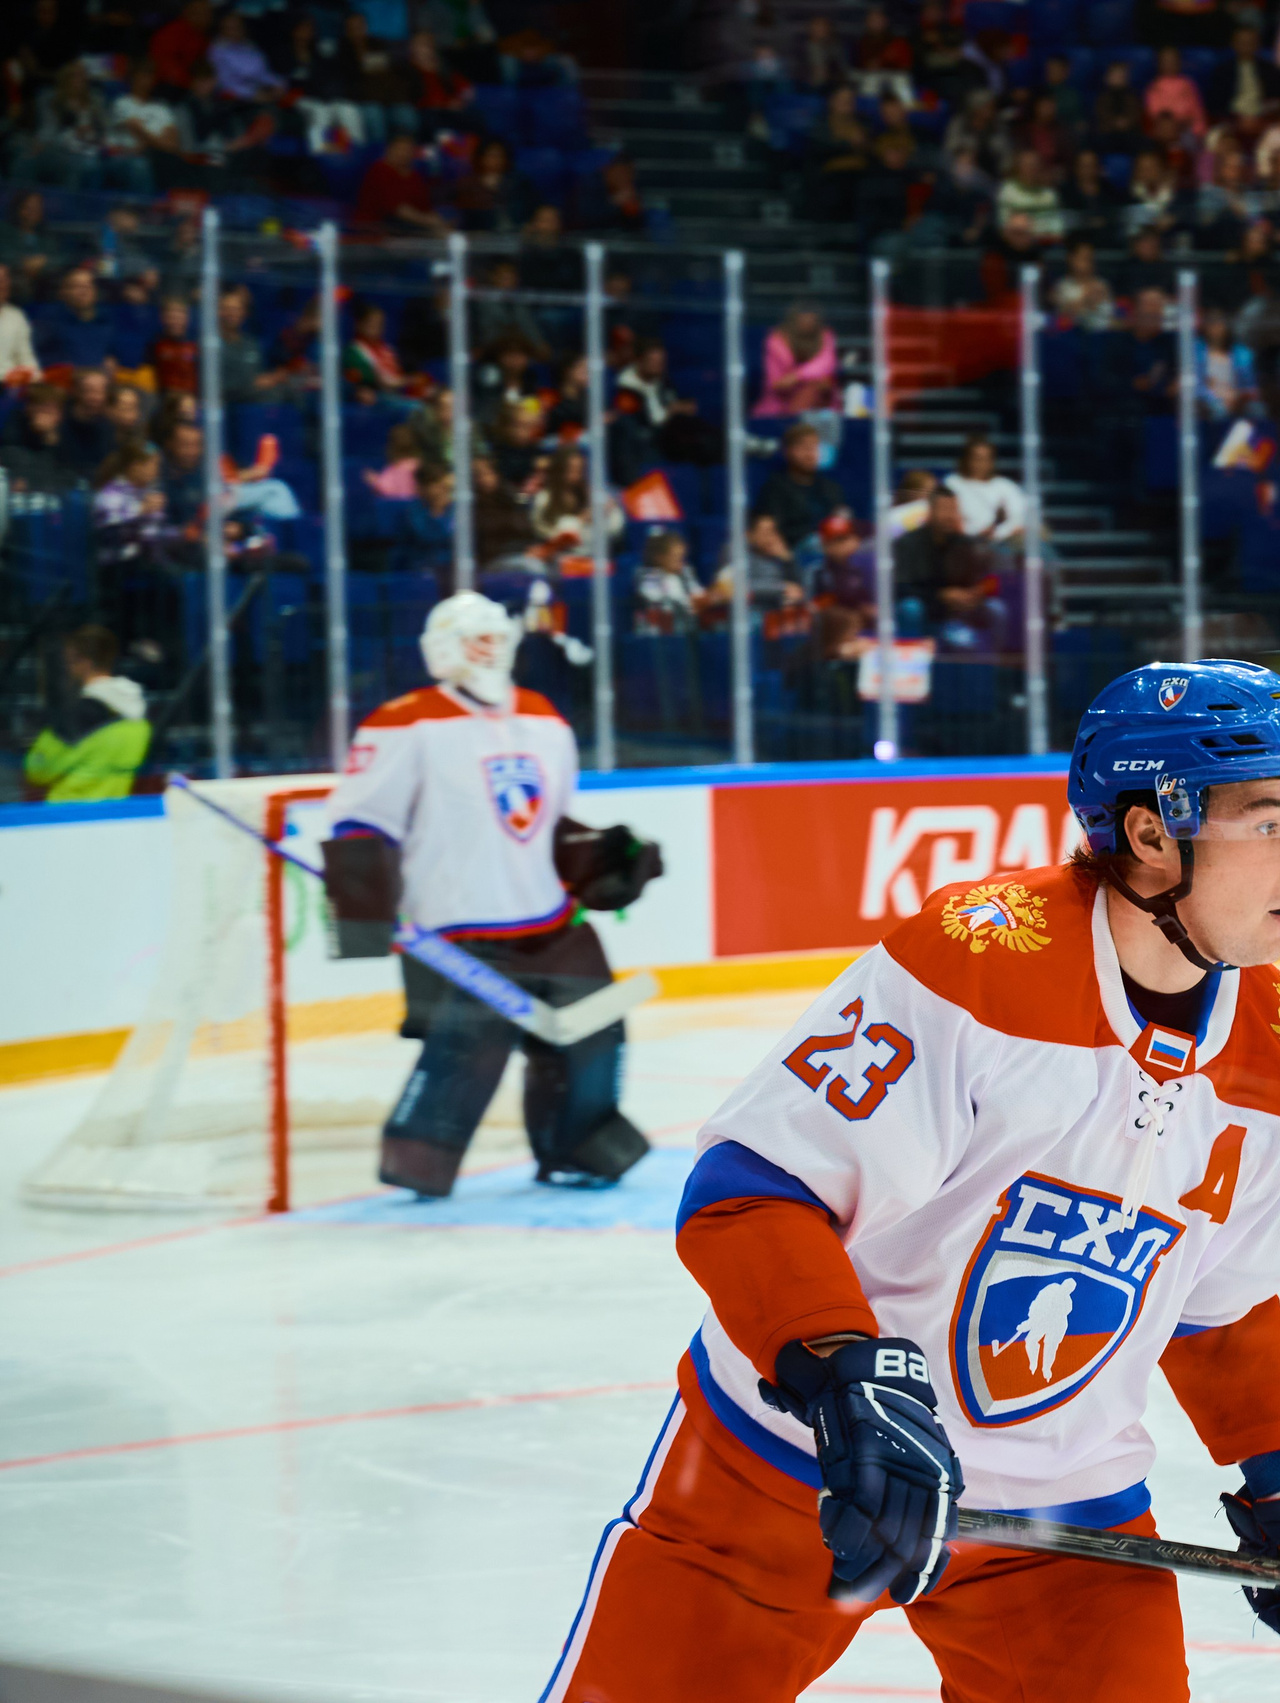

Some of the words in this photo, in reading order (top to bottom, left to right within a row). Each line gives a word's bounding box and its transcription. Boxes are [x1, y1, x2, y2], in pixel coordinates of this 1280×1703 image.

[1112, 760, 1165, 771] CCM
[781, 996, 915, 1121] 23
[999, 1184, 1171, 1281] СХЛ
